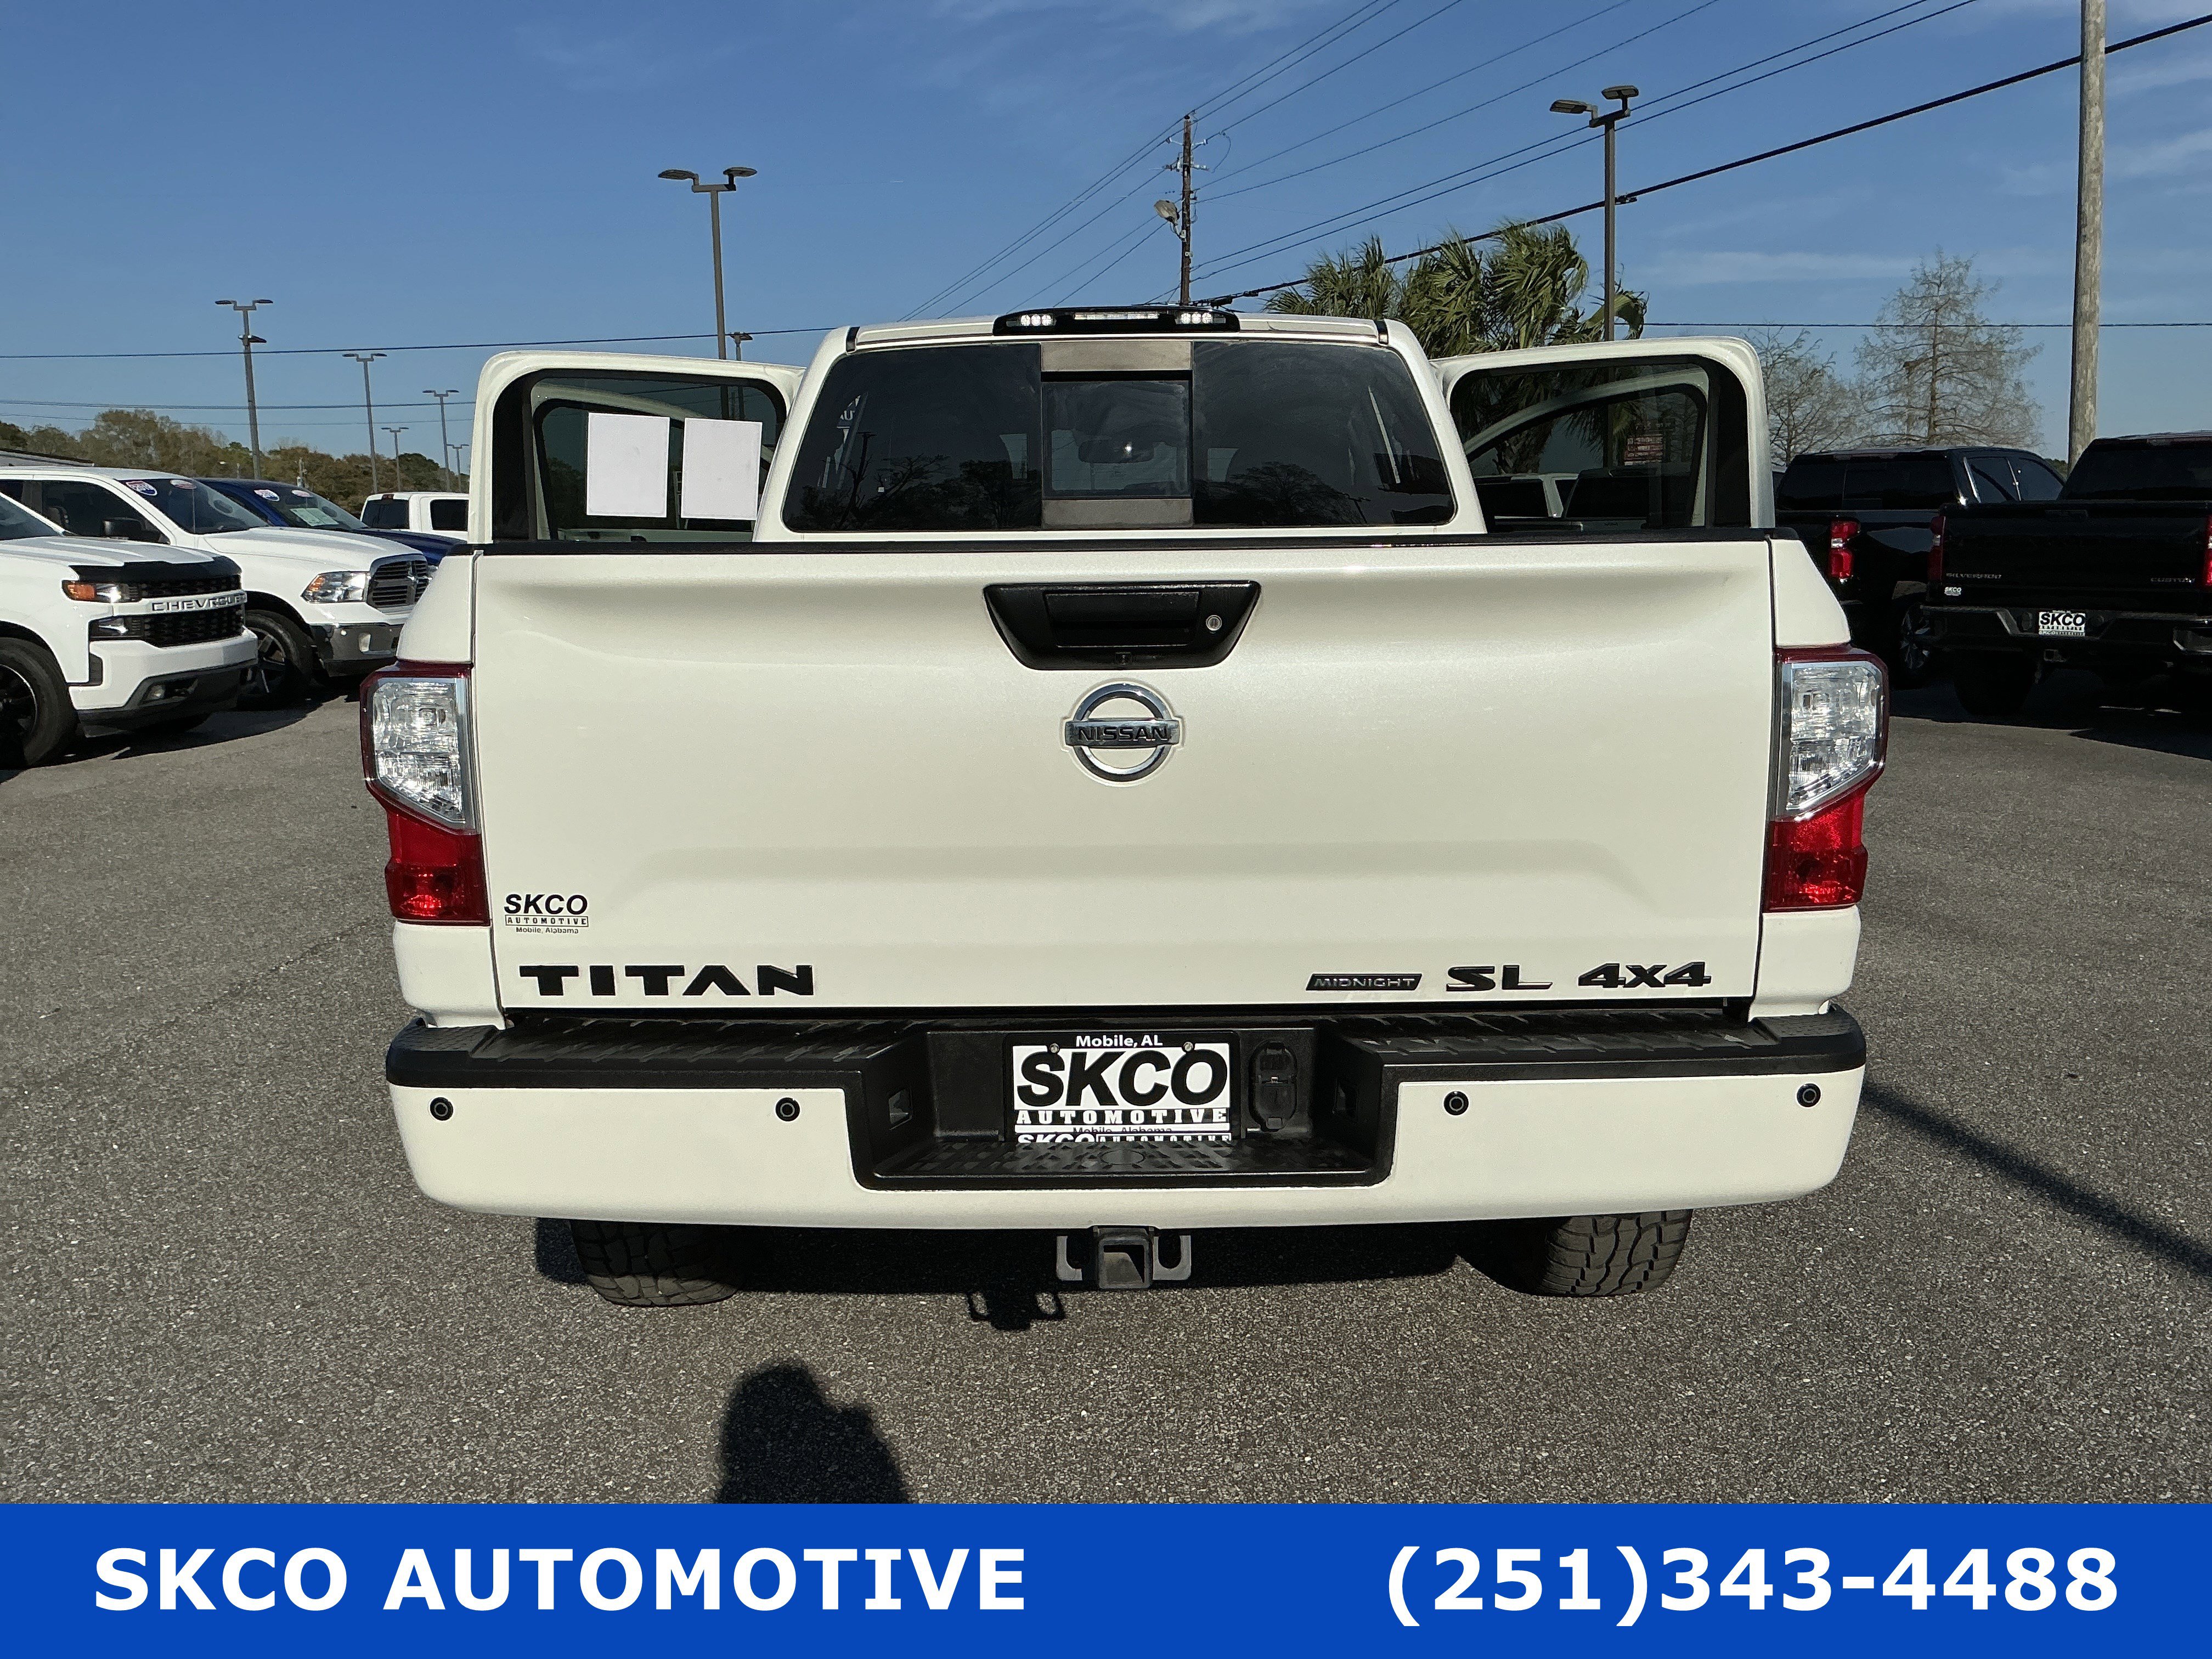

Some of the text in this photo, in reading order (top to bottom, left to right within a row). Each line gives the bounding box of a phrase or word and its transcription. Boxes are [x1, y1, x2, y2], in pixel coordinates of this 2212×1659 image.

[152, 592, 247, 612] CHEVROLET
[2040, 613, 2085, 626] SKCO
[1078, 726, 1169, 742] NISSAN
[504, 894, 588, 915] SKCO
[507, 917, 587, 925] AUTOMOTIVE
[519, 965, 814, 996] TITAN
[1314, 978, 1415, 987] MIDNIGHT
[1446, 965, 1553, 991] SL
[1076, 1035, 1163, 1048] Mobile, AL
[1017, 1049, 1228, 1107] SKCO
[1017, 1108, 1227, 1125] AUTOMOTIVE
